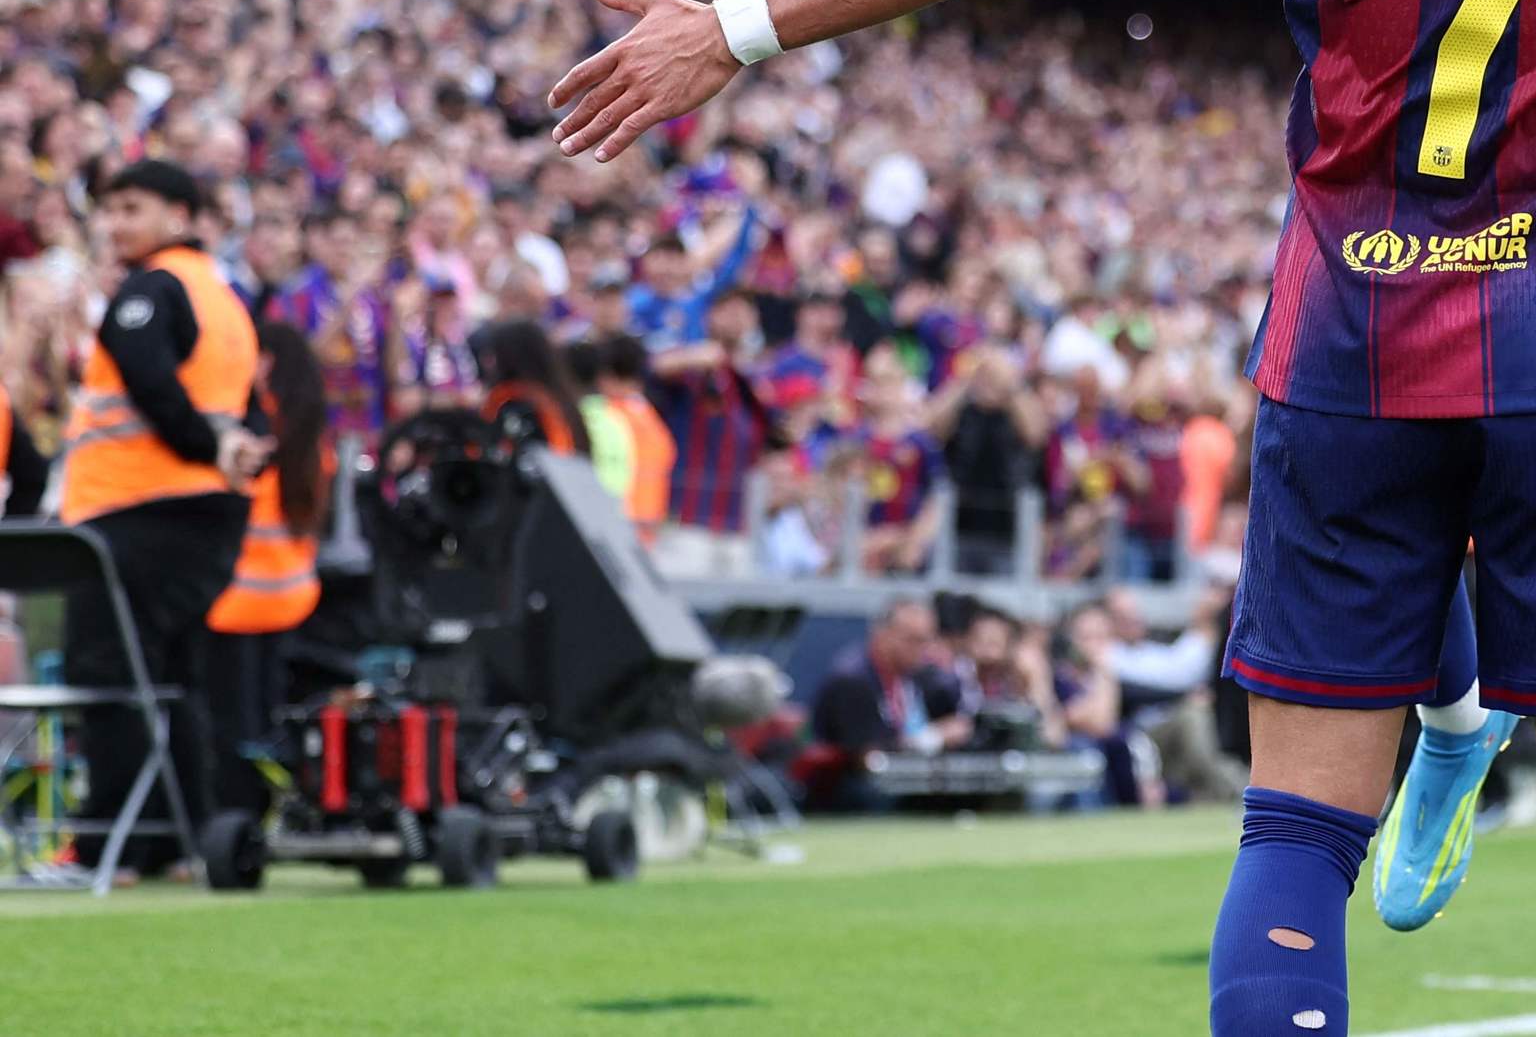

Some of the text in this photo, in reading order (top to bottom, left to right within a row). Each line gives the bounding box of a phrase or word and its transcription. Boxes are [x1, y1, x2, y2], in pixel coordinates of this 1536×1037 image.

[1438, 263, 1454, 272] UN
[1454, 262, 1492, 274] Refugee
[1492, 260, 1528, 272] Agency
